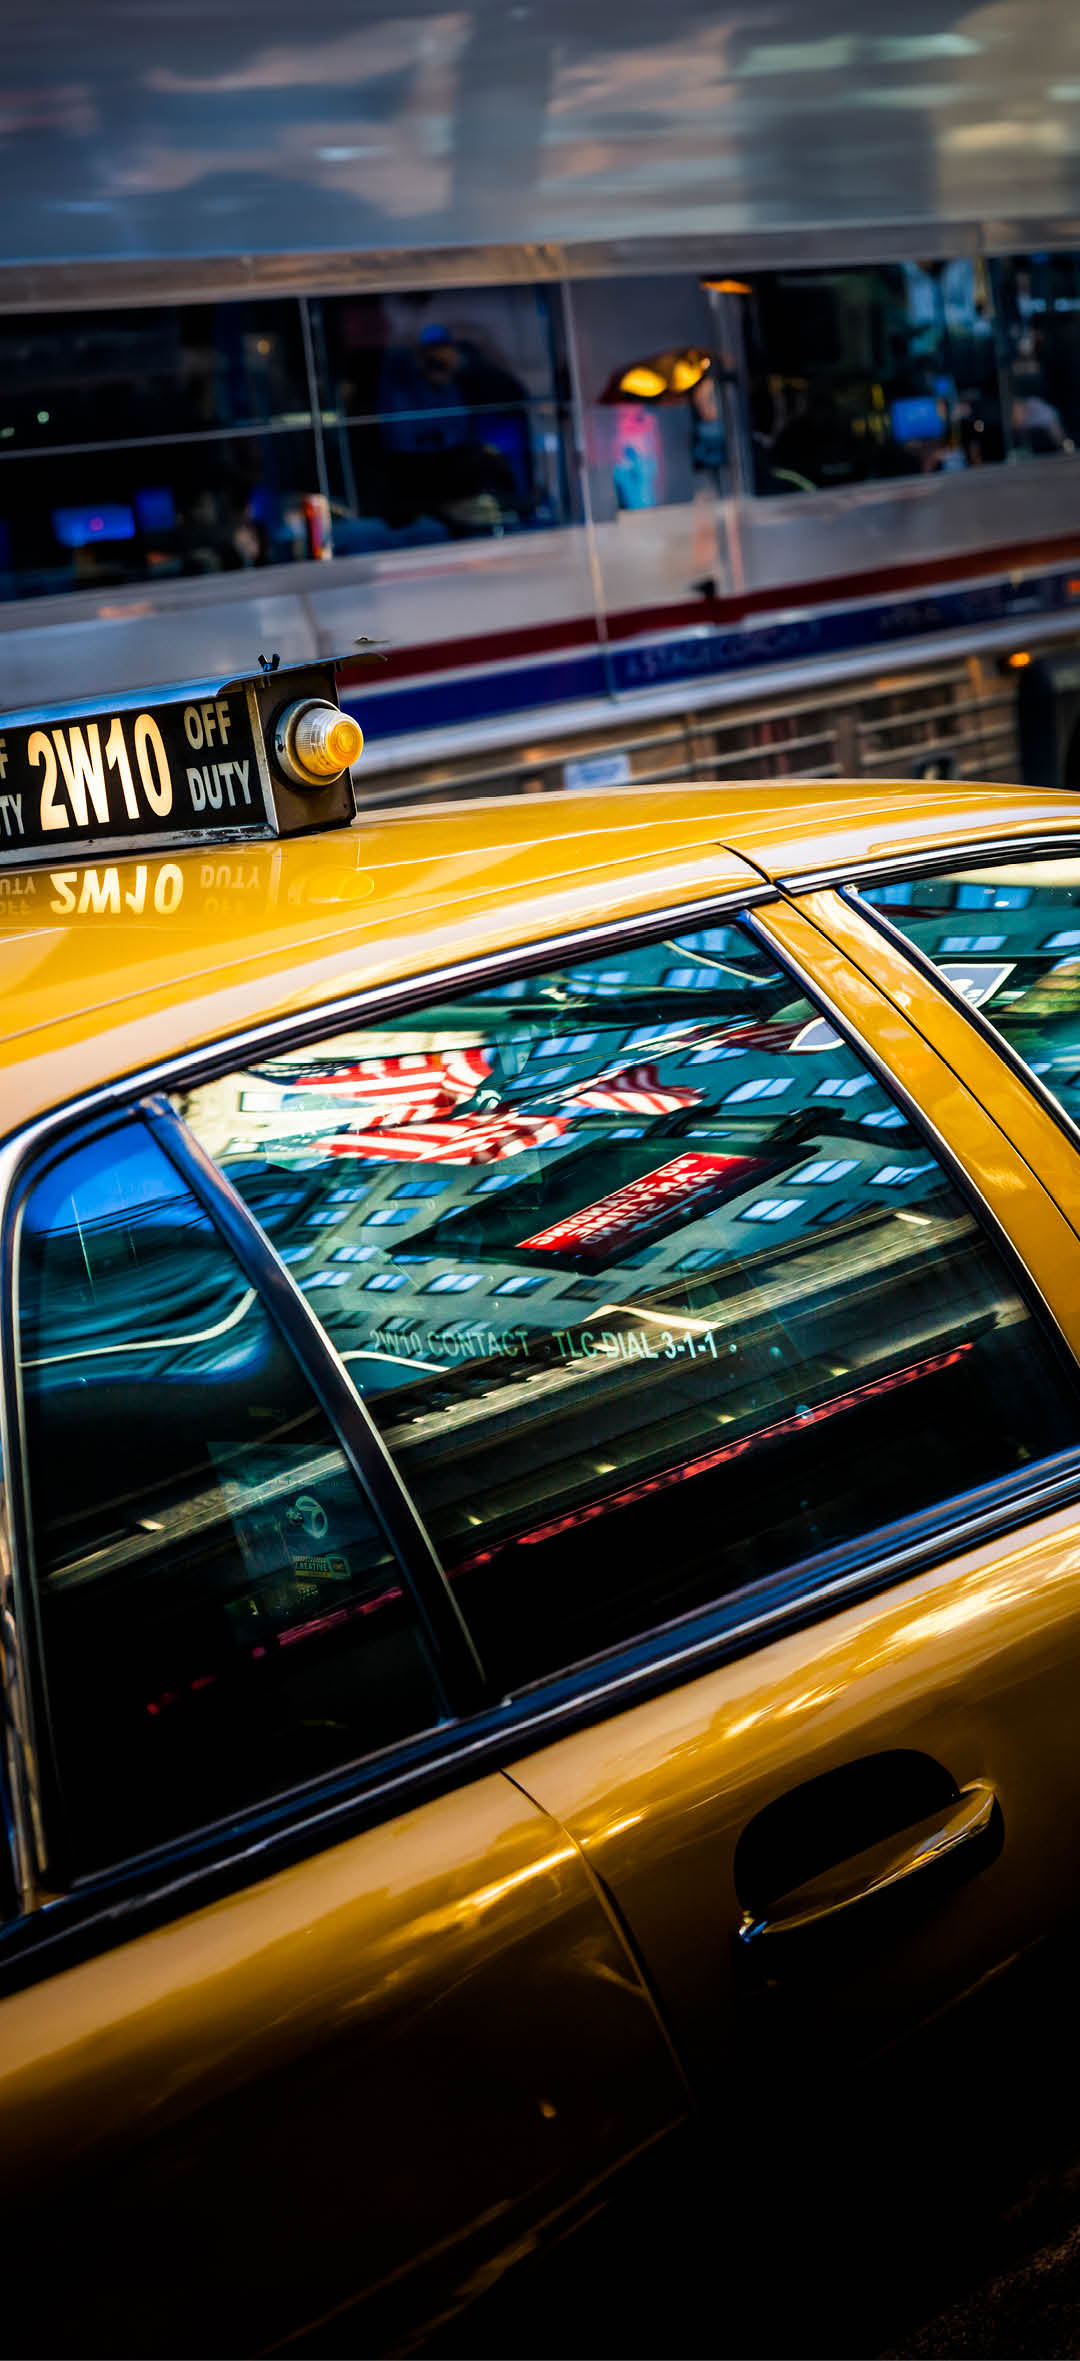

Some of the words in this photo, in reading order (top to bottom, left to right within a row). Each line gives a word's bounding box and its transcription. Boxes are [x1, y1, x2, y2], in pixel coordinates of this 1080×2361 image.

[183, 700, 232, 750] OFF
[28, 713, 173, 831] 2W10
[186, 759, 252, 811] DUTY
[369, 1329, 424, 1354] 2W10
[427, 1330, 530, 1357] CONTACT
[551, 1331, 598, 1358] TLC
[600, 1331, 660, 1359] DIAL
[660, 1331, 719, 1359] 3-1-1
